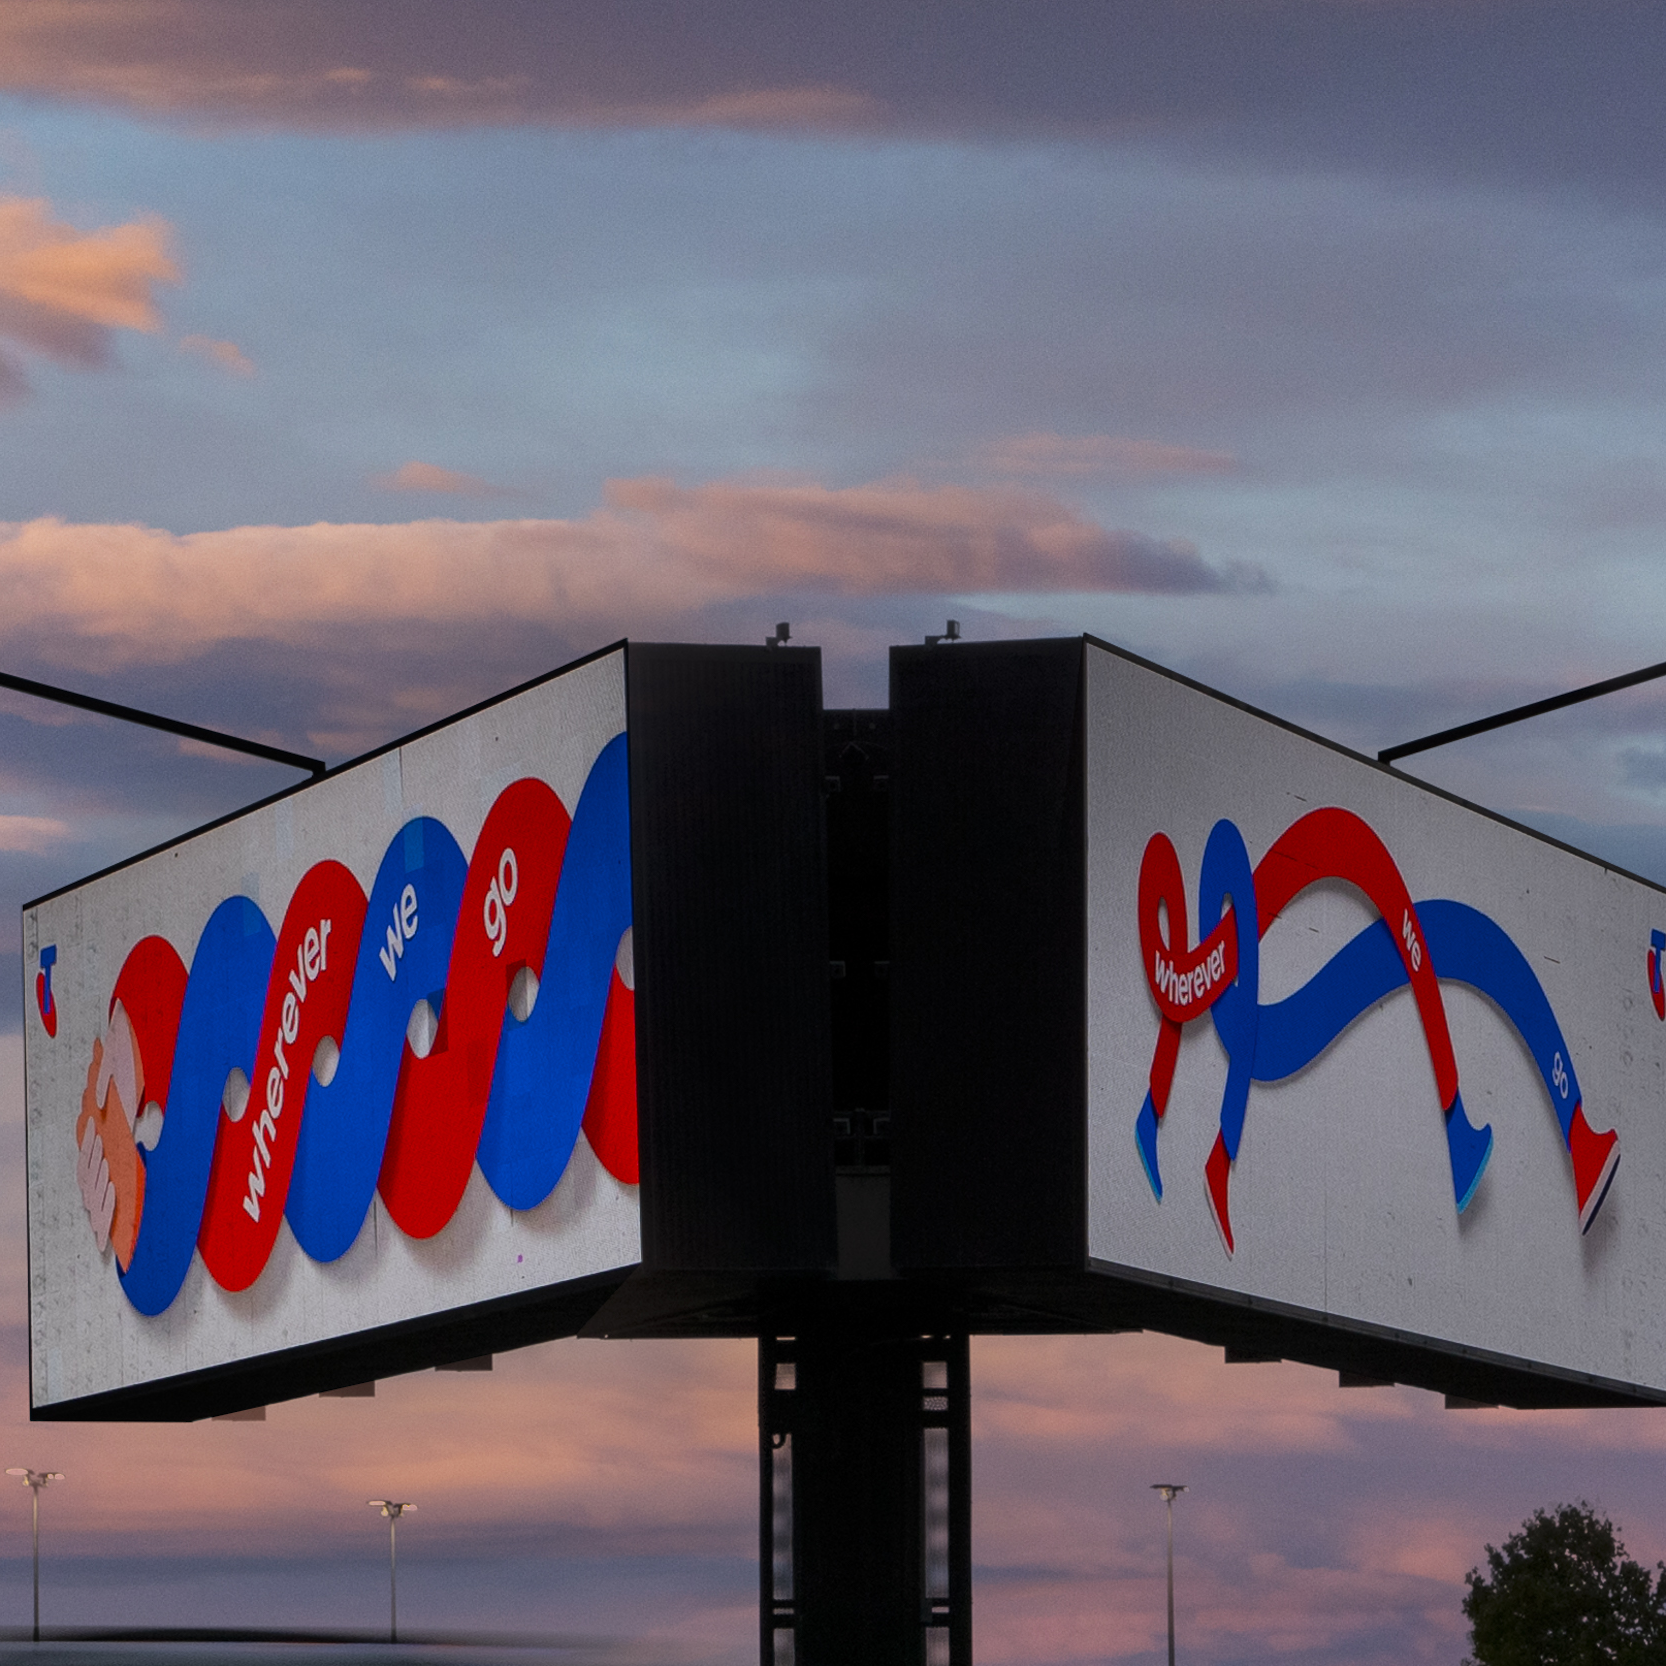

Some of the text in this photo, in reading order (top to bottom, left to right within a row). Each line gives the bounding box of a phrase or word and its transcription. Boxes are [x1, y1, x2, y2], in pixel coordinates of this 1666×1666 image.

[242, 847, 519, 1223] wherever we go
[1155, 909, 1569, 1099] wherever we go
